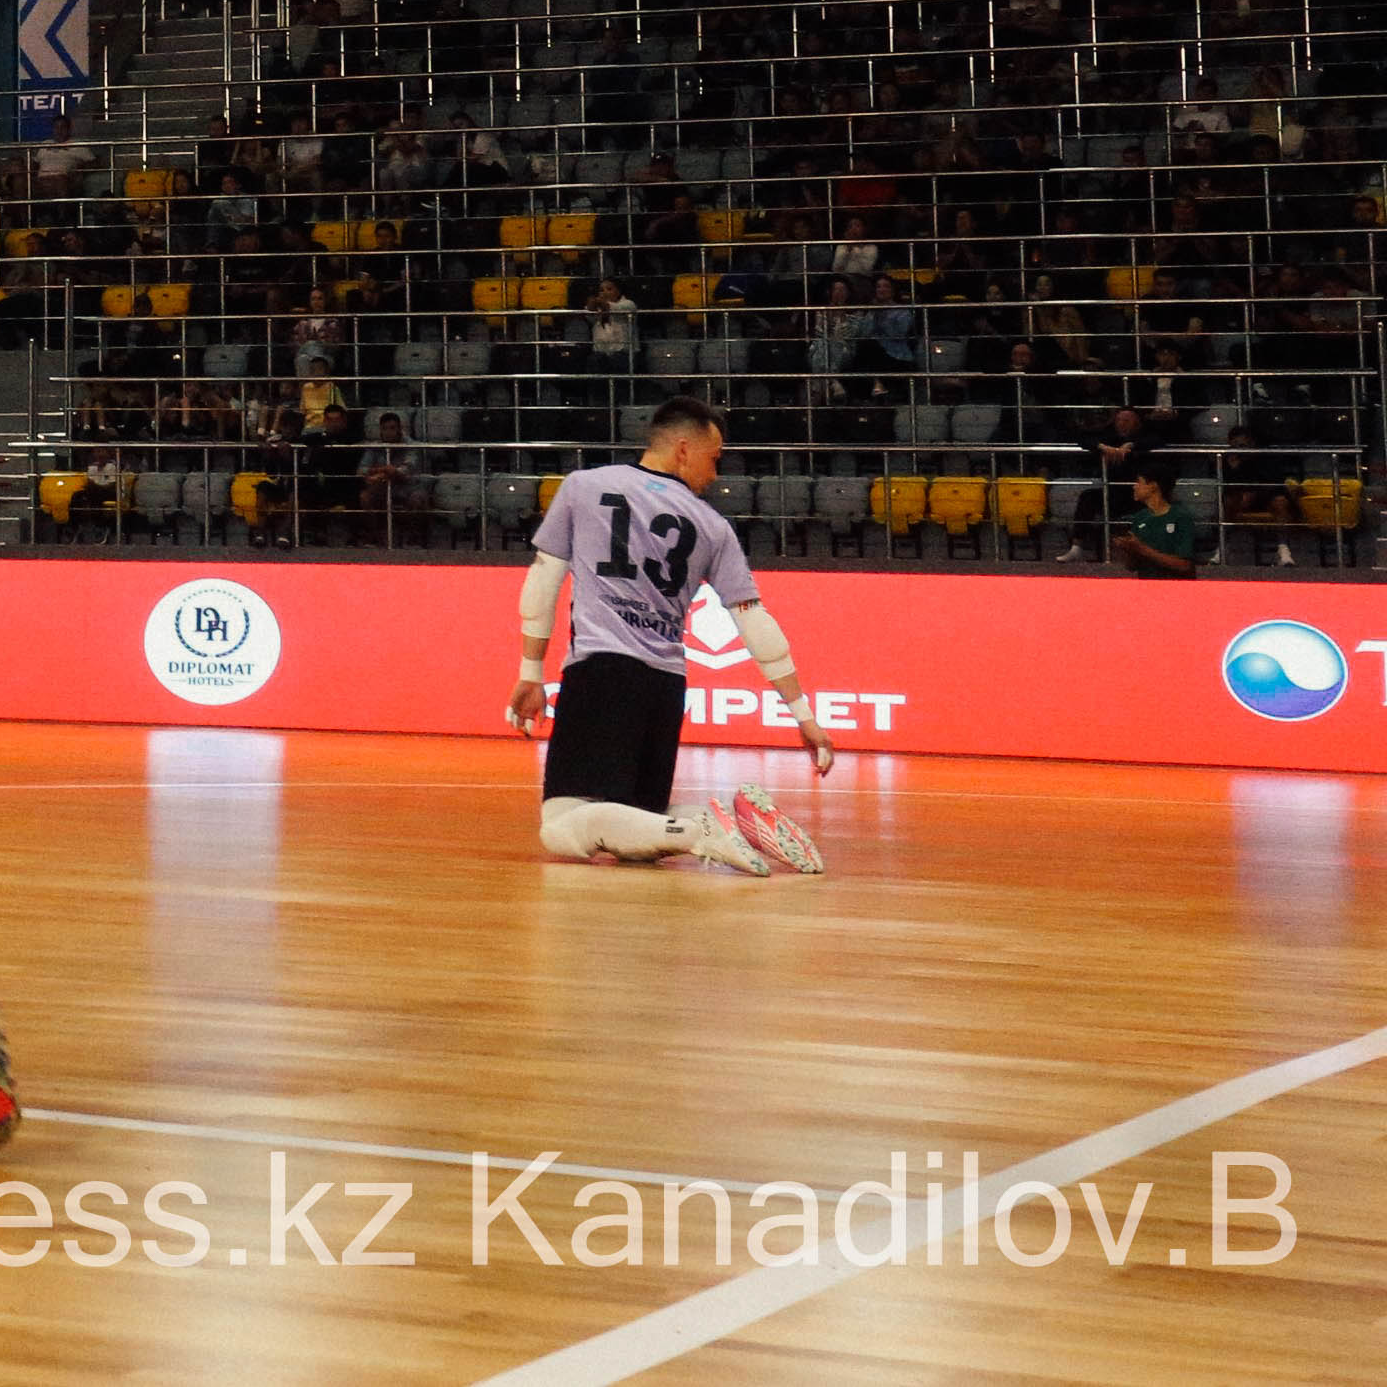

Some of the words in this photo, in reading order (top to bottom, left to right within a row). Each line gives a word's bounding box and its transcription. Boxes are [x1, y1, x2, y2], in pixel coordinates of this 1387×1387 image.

[597, 492, 697, 597] 13
[168, 661, 255, 675] DIPLOMAT
[188, 677, 234, 686] HOTELS
[544, 682, 906, 731] MPBET
